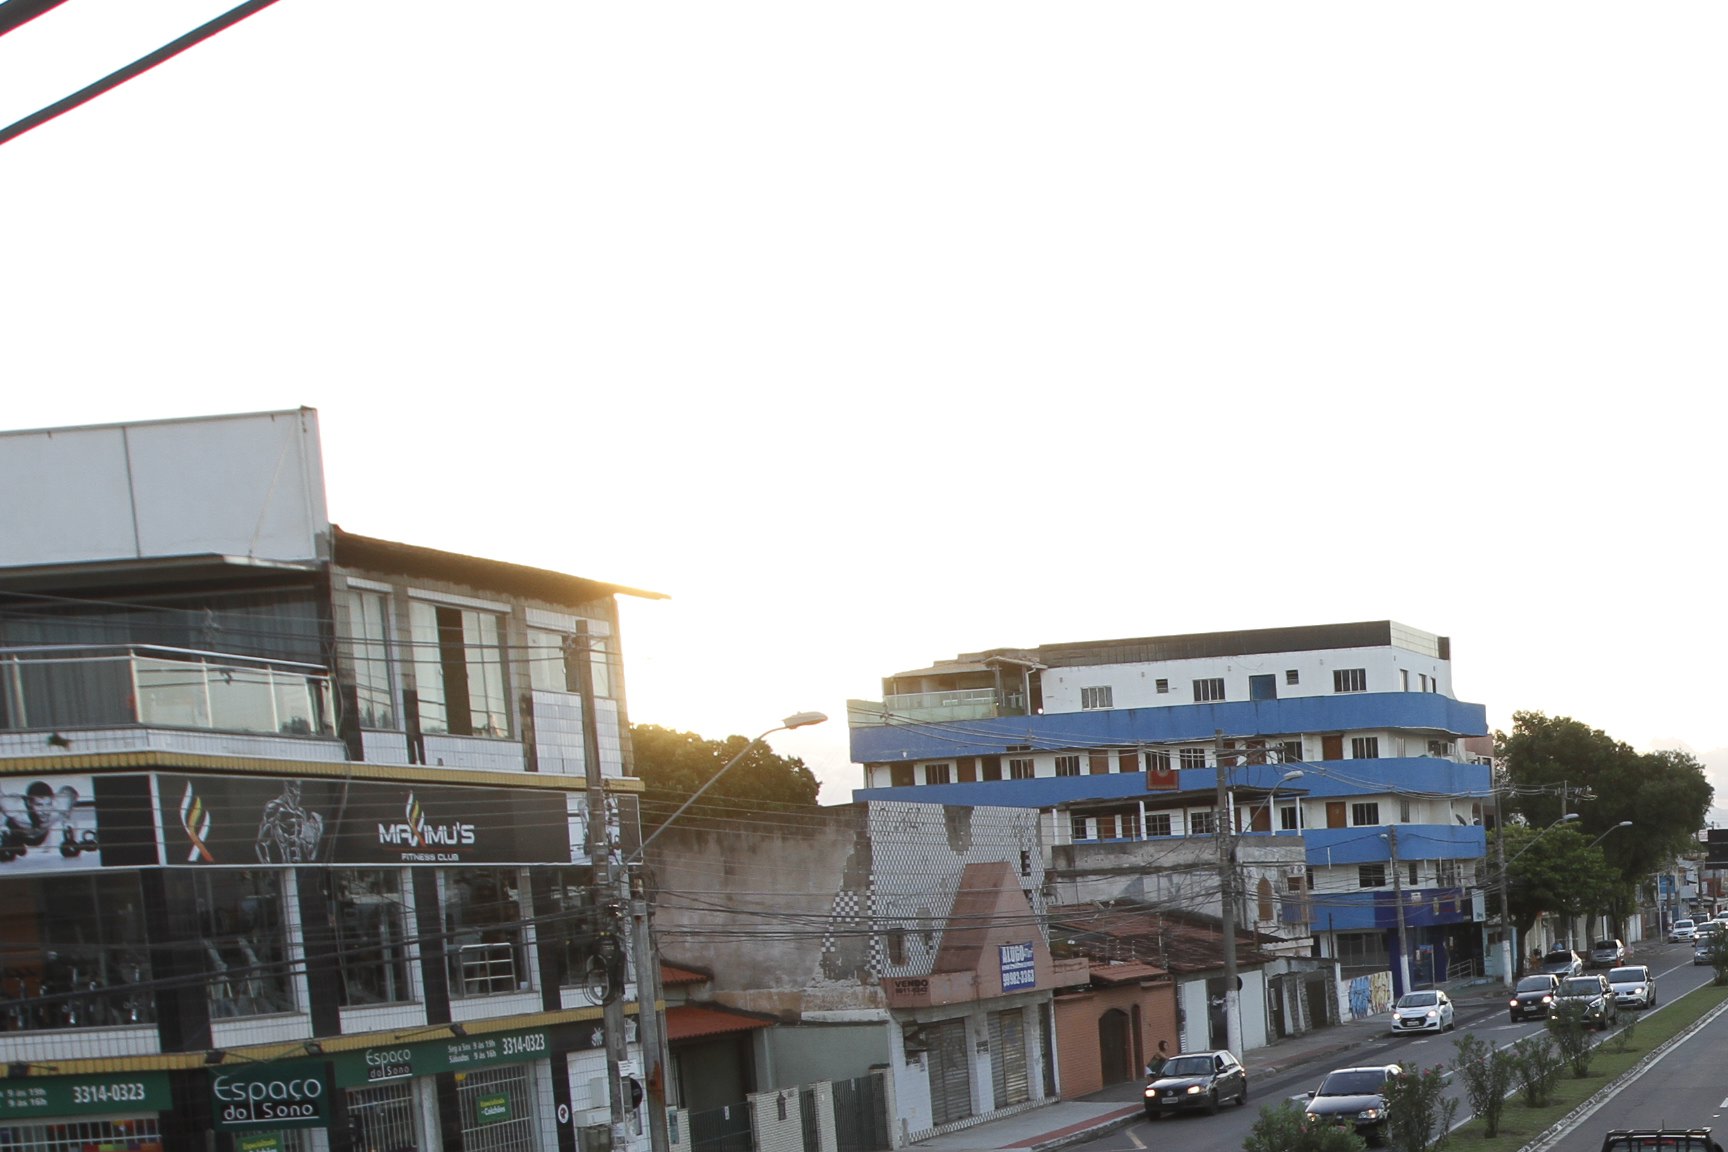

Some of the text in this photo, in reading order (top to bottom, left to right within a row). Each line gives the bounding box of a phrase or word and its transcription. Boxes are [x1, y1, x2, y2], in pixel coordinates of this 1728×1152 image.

[378, 817, 476, 847] MAXIMU'S
[401, 853, 459, 861] FITNESS CLUB
[895, 979, 928, 987] VENDO
[502, 1033, 545, 1055] 3314-0323
[366, 1049, 411, 1068] Espaço
[387, 1065, 410, 1076] Sono
[73, 1083, 145, 1103] 3314-0323
[214, 1076, 321, 1120] Espaço
[224, 1102, 313, 1120] do Sono
